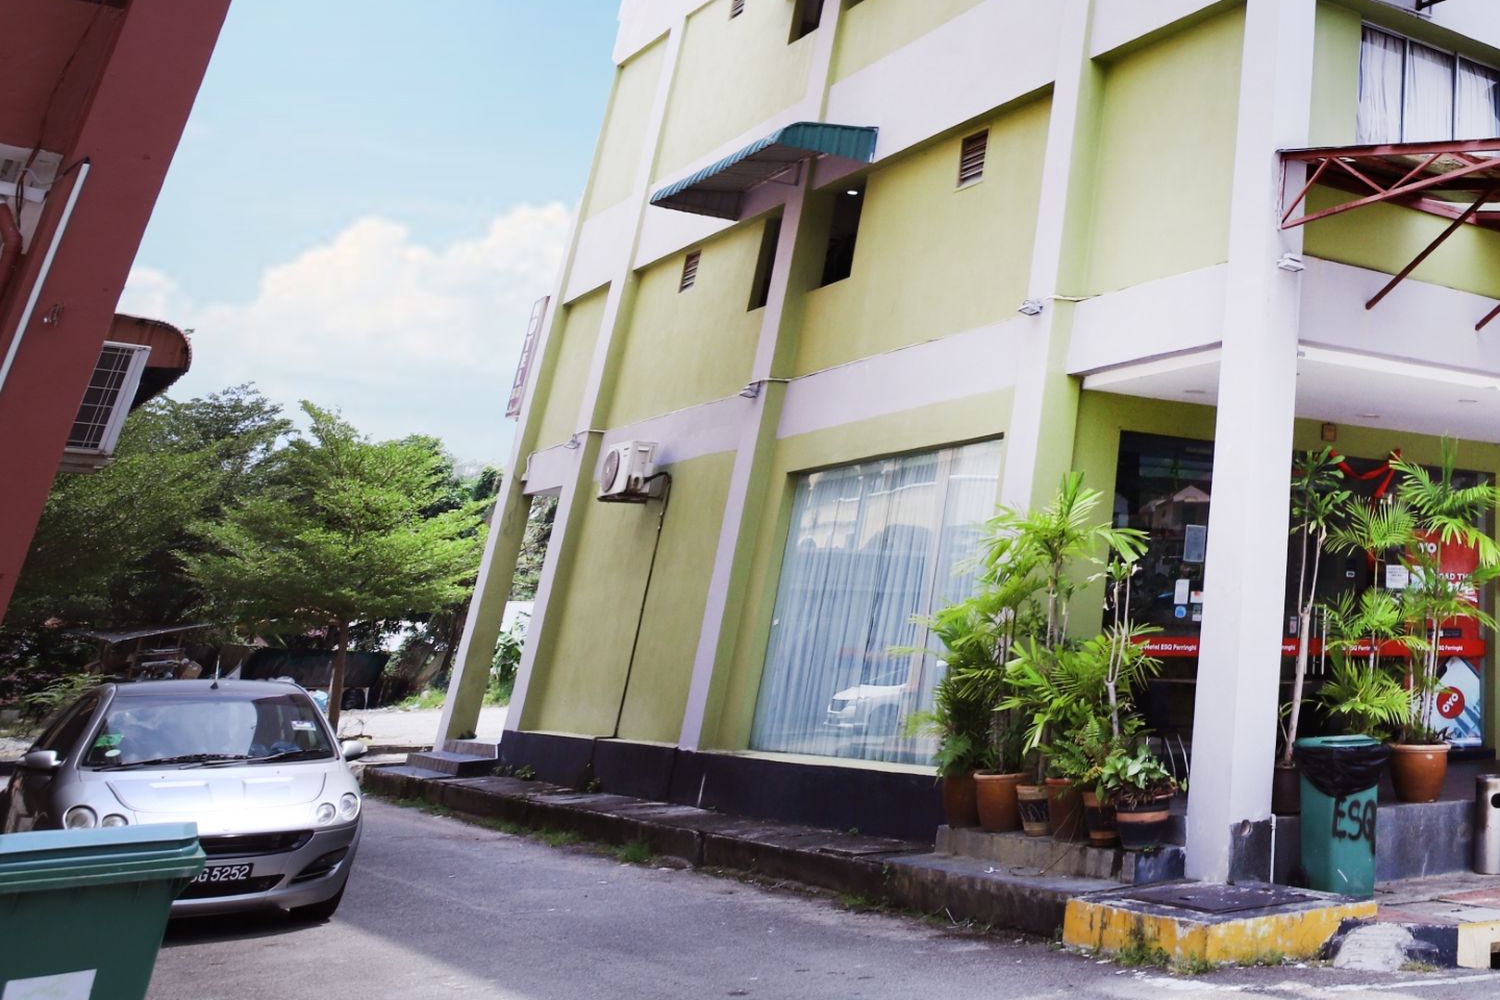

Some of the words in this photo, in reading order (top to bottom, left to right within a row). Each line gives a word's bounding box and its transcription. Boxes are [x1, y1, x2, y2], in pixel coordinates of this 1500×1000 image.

[1442, 692, 1459, 713] OYO
[1332, 792, 1377, 856] ESQ
[210, 865, 250, 882] 5252
